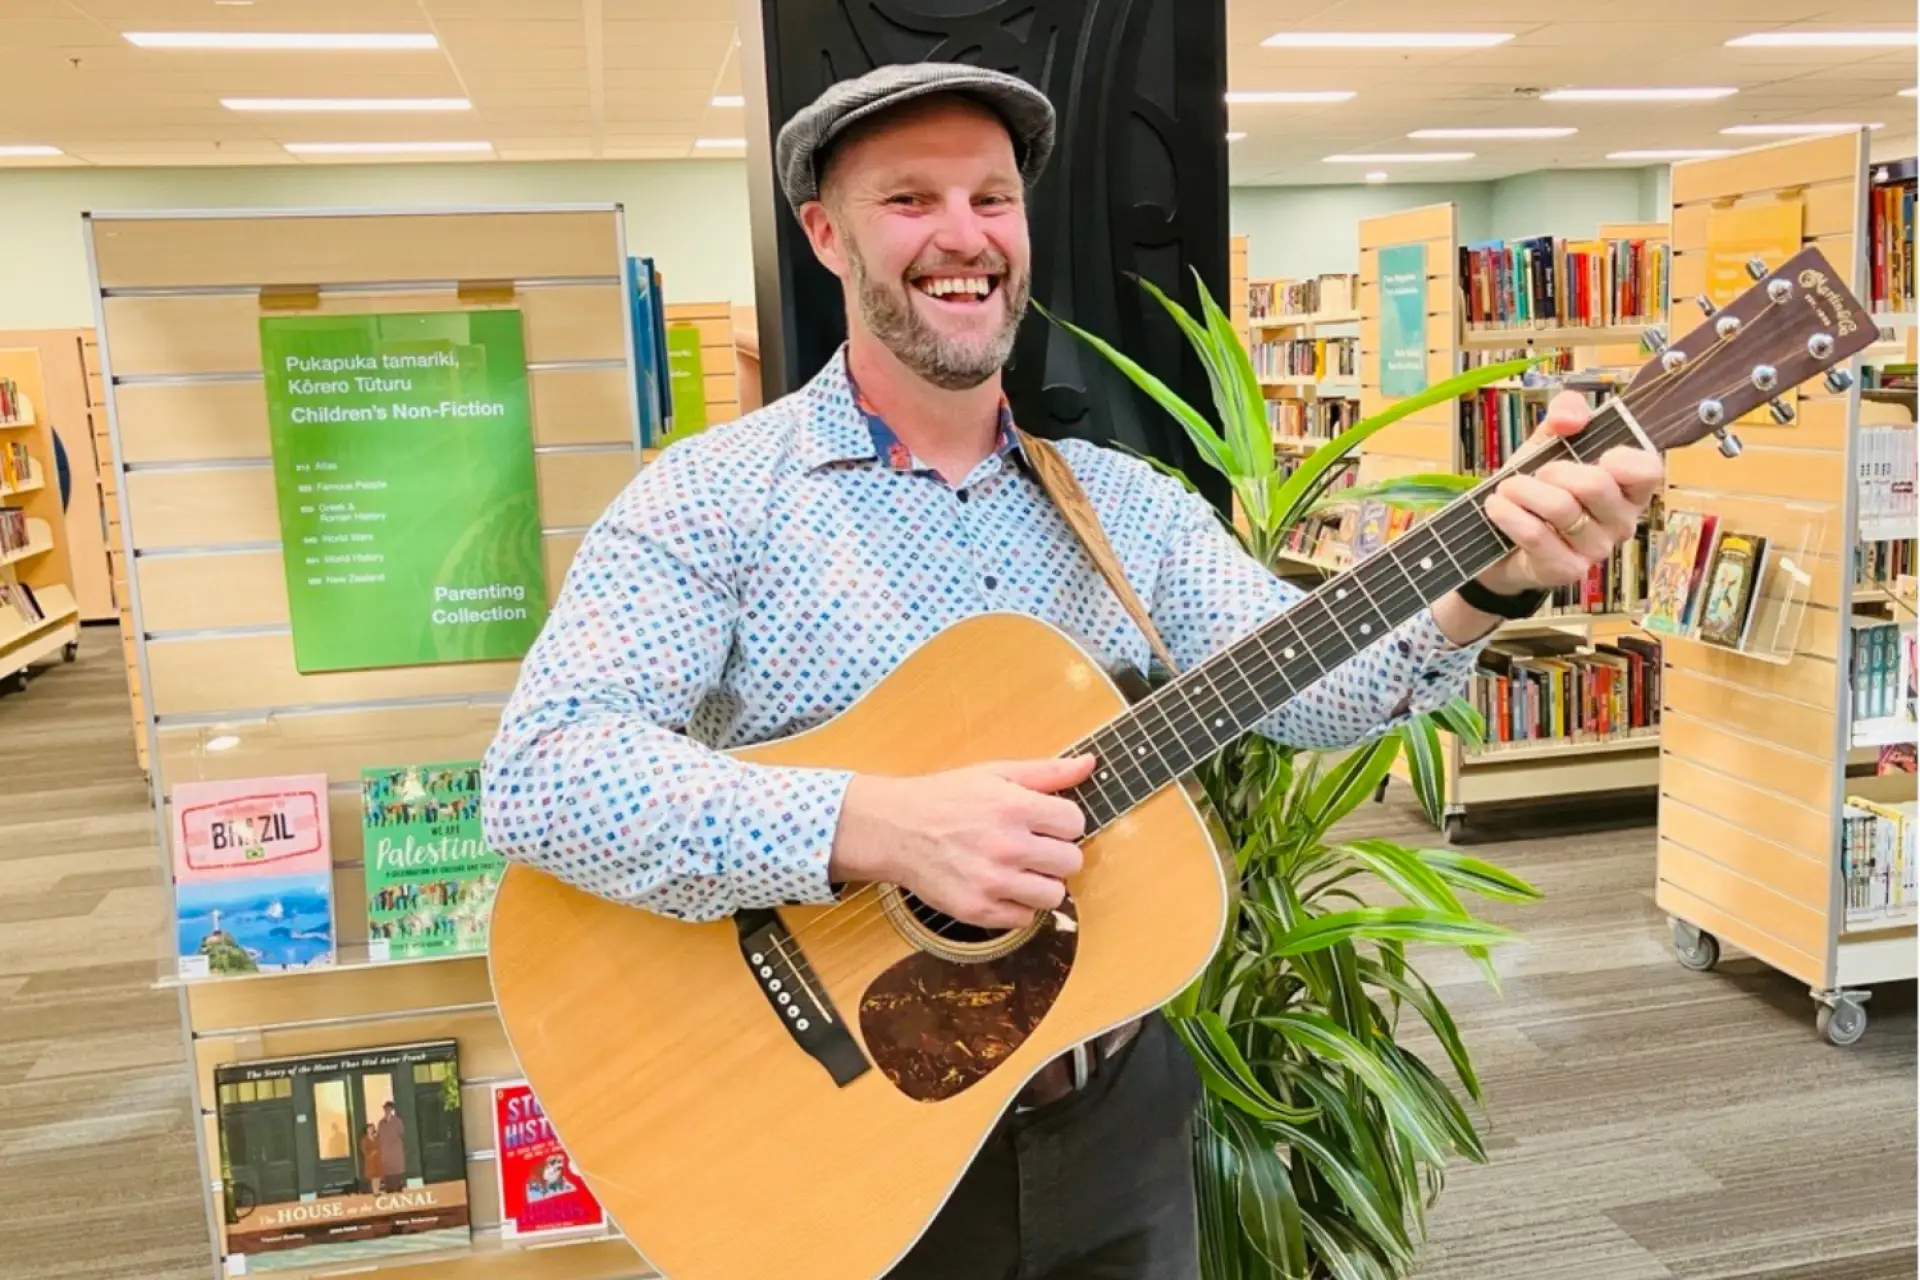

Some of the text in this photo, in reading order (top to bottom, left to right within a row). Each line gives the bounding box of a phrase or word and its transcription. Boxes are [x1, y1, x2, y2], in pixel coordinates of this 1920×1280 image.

[285, 351, 459, 374] Pukapuka tamariki,
[288, 376, 412, 395] Kōrero Tūturu
[291, 400, 504, 424] Children's Non-Fiction
[317, 482, 354, 491] Famous
[355, 480, 387, 490] People
[354, 512, 386, 522] History
[322, 533, 348, 544] World
[324, 553, 351, 564] World
[353, 552, 384, 564] History
[326, 575, 347, 584] New
[348, 573, 385, 583] Zealand
[435, 584, 525, 602] Parenting
[432, 606, 527, 624] Collection
[246, 1051, 426, 1079] The Story of the House That Hid Anne Frank
[505, 1118, 555, 1148] HIST
[276, 1202, 344, 1224] HOUSE
[375, 1191, 438, 1211] CANAL
